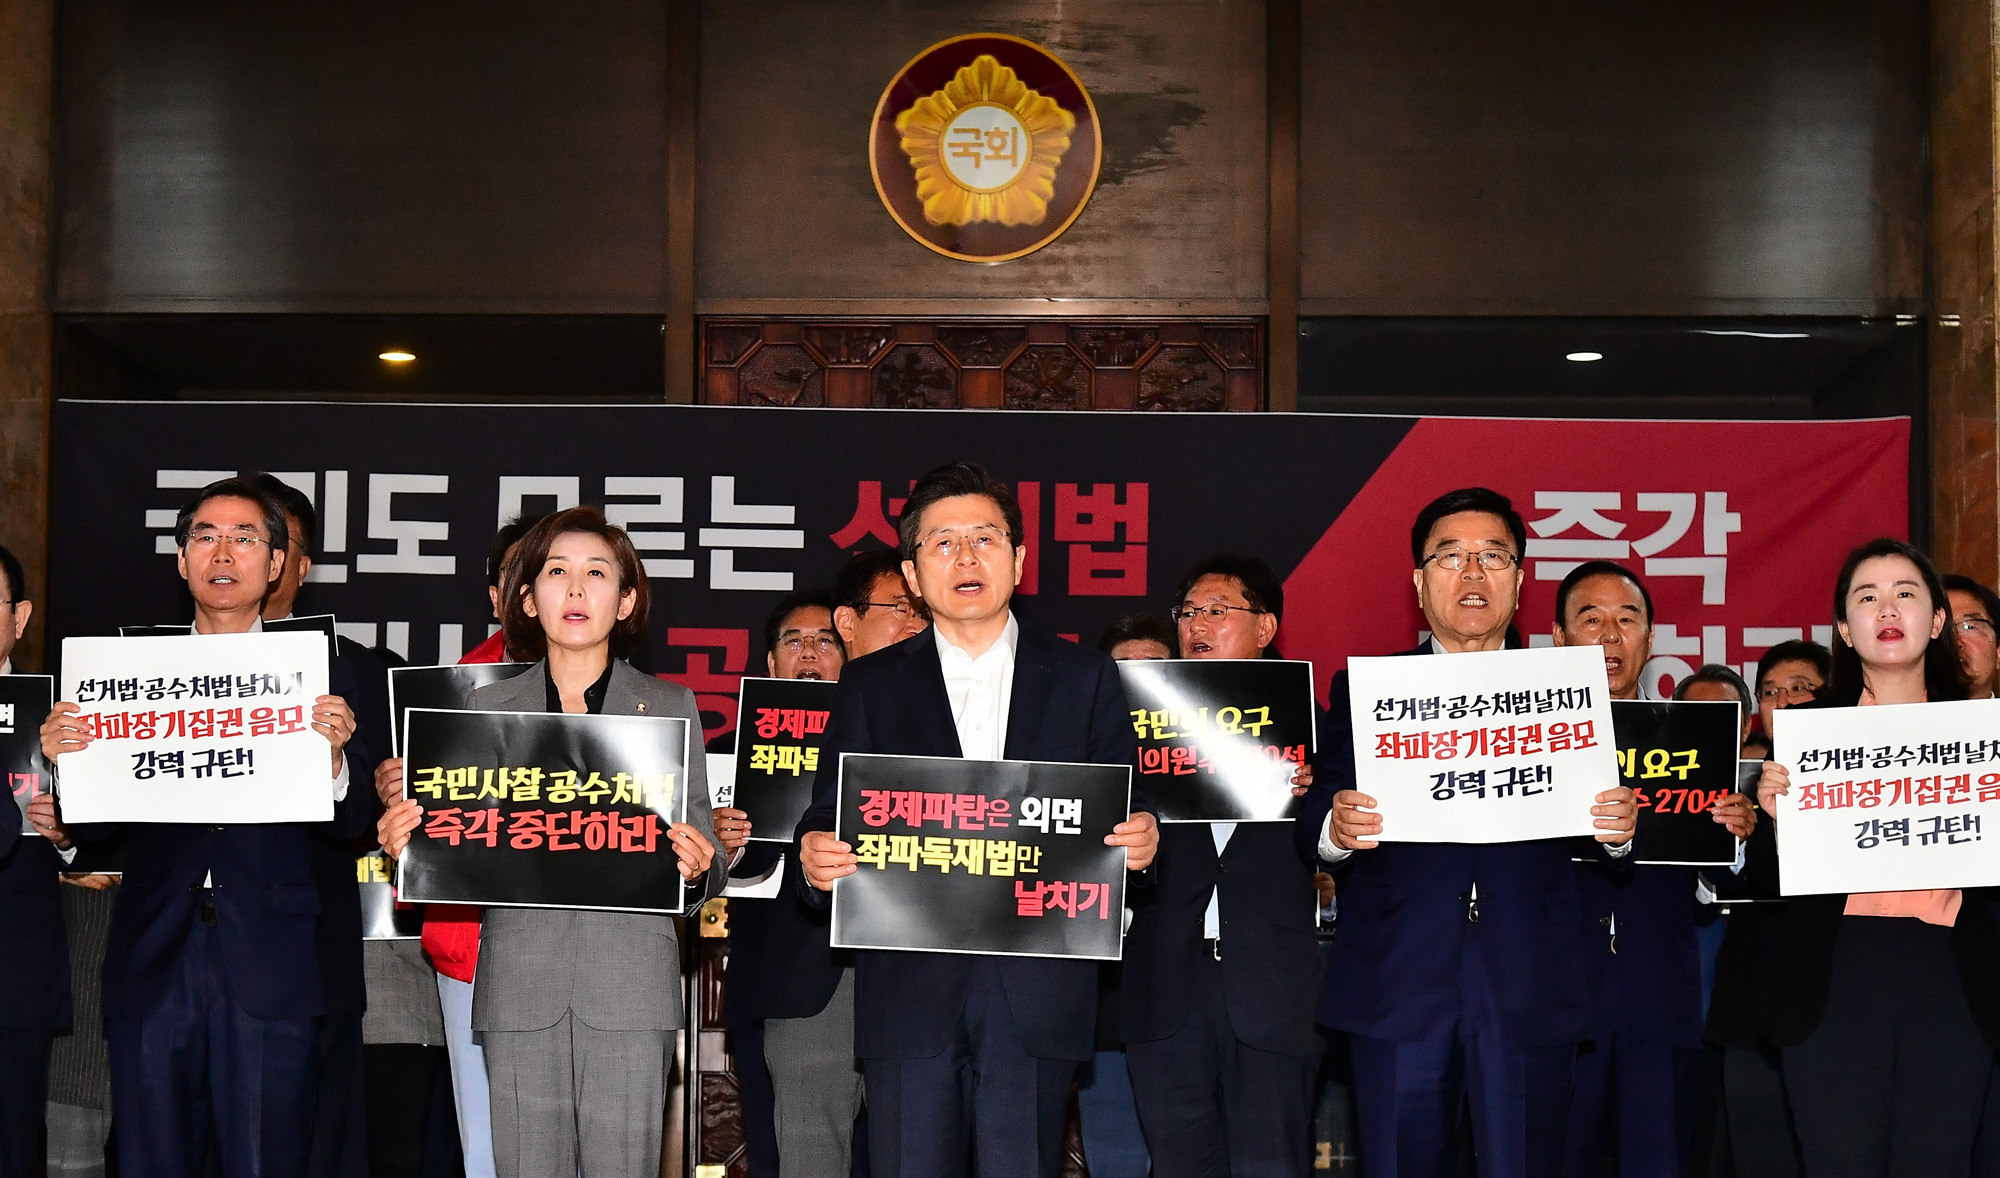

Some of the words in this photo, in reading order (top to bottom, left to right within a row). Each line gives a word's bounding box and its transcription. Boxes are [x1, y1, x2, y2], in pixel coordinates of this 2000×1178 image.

[948, 126, 1018, 168] 국회
[1524, 490, 1741, 605] 즉각
[1534, 687, 1592, 711] 날치기
[248, 705, 306, 737] 음모
[1130, 706, 1209, 740] 국민의
[1215, 706, 1273, 737] 요구
[1375, 722, 1543, 760] 좌파장기집권
[1547, 720, 1598, 753] 음모
[131, 750, 185, 779] 강력
[191, 747, 254, 779] 규탄!
[1429, 769, 1486, 800] 강력
[1492, 764, 1553, 798] 규탄!
[1640, 748, 1700, 780] 요구
[413, 766, 545, 802] 국민사찰
[546, 769, 676, 808] 공수처법
[1798, 773, 1971, 811] 좌파장기집권
[424, 807, 504, 848] 즉각
[507, 809, 662, 853] 중단하라
[859, 789, 1012, 830] 경제파탄은
[1018, 797, 1082, 835] 외면
[1854, 817, 1910, 849] 강력
[1916, 813, 1982, 846] 규탄!
[856, 833, 1042, 877] 좌파독재법만
[1014, 880, 1110, 920] 날치기
